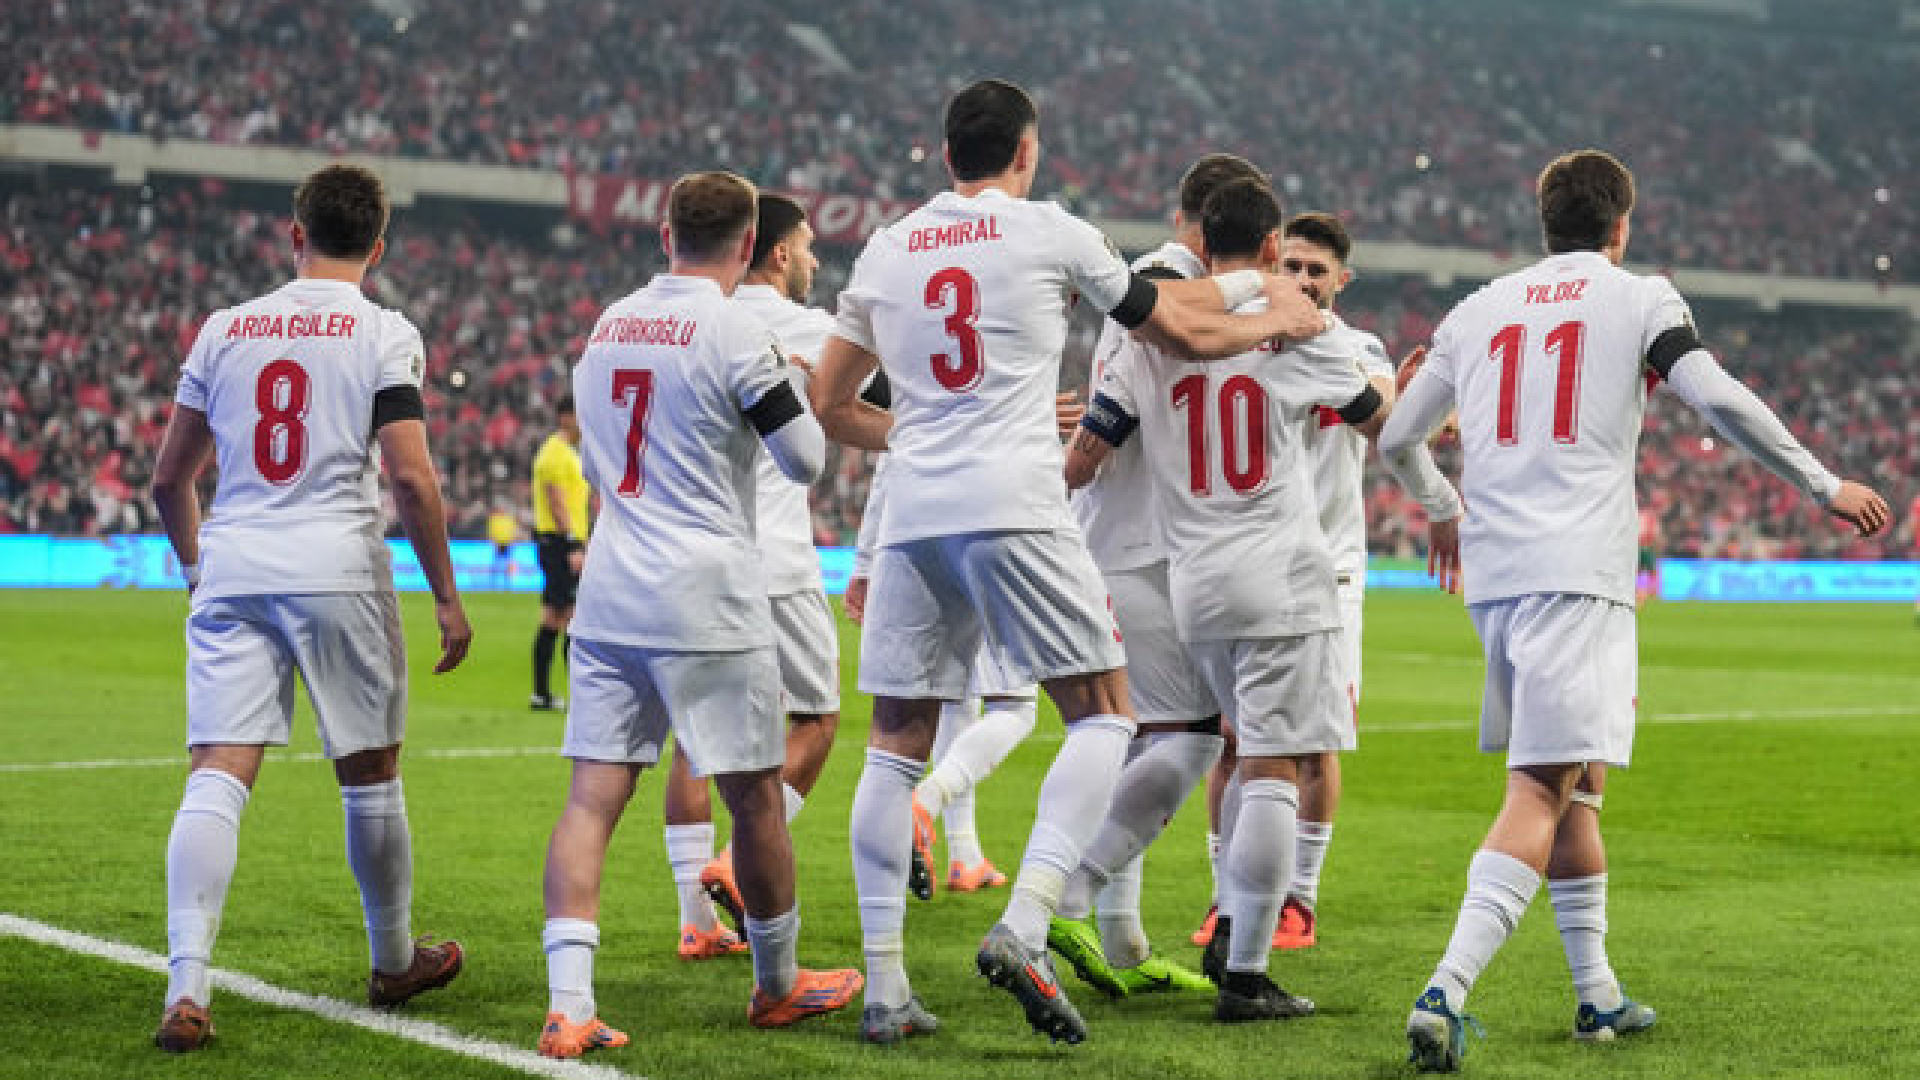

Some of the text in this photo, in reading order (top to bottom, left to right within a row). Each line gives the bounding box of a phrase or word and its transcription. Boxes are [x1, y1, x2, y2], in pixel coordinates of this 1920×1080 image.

[225, 314, 283, 339] ARDA
[924, 266, 984, 393] 3
[1488, 320, 1587, 447] 11
[254, 359, 312, 487] 8
[612, 369, 656, 498] 7
[1170, 374, 1272, 499] 10
